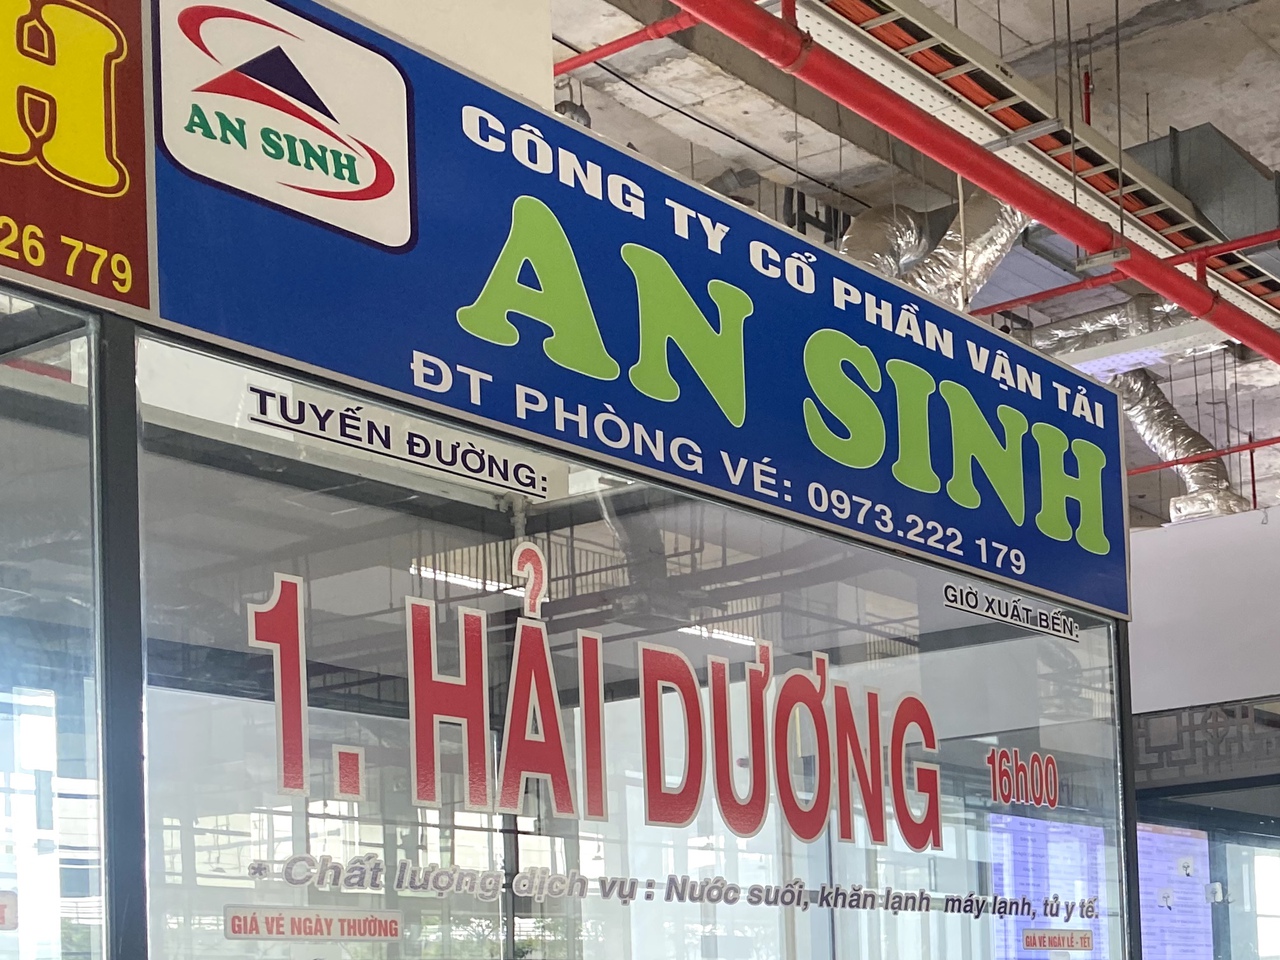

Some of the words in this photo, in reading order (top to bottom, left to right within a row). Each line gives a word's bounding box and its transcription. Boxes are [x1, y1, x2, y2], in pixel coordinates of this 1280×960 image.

[184, 103, 248, 151] AN
[261, 127, 360, 185] SINH
[60, 236, 132, 293] 779
[462, 105, 645, 220] CÔNG
[665, 198, 730, 254] TY
[749, 240, 816, 293] CỔ
[833, 277, 953, 359] PHẦN
[966, 340, 1041, 400] VẬN
[1052, 381, 1105, 429] TẢI
[456, 195, 754, 428] AN
[803, 328, 1111, 555] SINH
[249, 384, 392, 450] TUYẾN
[406, 434, 549, 493] ĐƯỜNG:
[410, 350, 493, 406] ĐT
[515, 383, 704, 475] PHÒNG
[719, 450, 792, 502] VÉ:
[808, 482, 964, 556] 0973.222
[975, 537, 1026, 575] 179
[944, 584, 978, 610] GIỜ
[985, 596, 1032, 625] XUẤT
[1038, 609, 1079, 638] BẾN:
[247, 572, 365, 800] 1.
[405, 541, 609, 823] HẢI
[637, 639, 944, 853] DƯƠNG
[985, 747, 1060, 810] 16h00
[231, 912, 260, 936] GIÁ
[265, 913, 285, 936] VÉ
[290, 914, 333, 937] NGÀY
[338, 914, 399, 938] THƯỜNG
[282, 852, 386, 892] Chất
[395, 860, 501, 900] lượng
[512, 866, 588, 903] dịch
[599, 876, 638, 906] vụ
[664, 874, 740, 906] Nước
[747, 876, 809, 912] suối,
[818, 881, 876, 911] khăn
[885, 885, 931, 915] lạnh
[944, 893, 987, 920] máy
[991, 895, 1036, 920] lạnh,
[1043, 894, 1060, 918] tủ
[1064, 901, 1076, 923] y
[1079, 896, 1099, 919] tế.
[1025, 934, 1037, 947] GIÁ
[1038, 934, 1047, 947] VÉ
[1048, 934, 1066, 947] NGÀY
